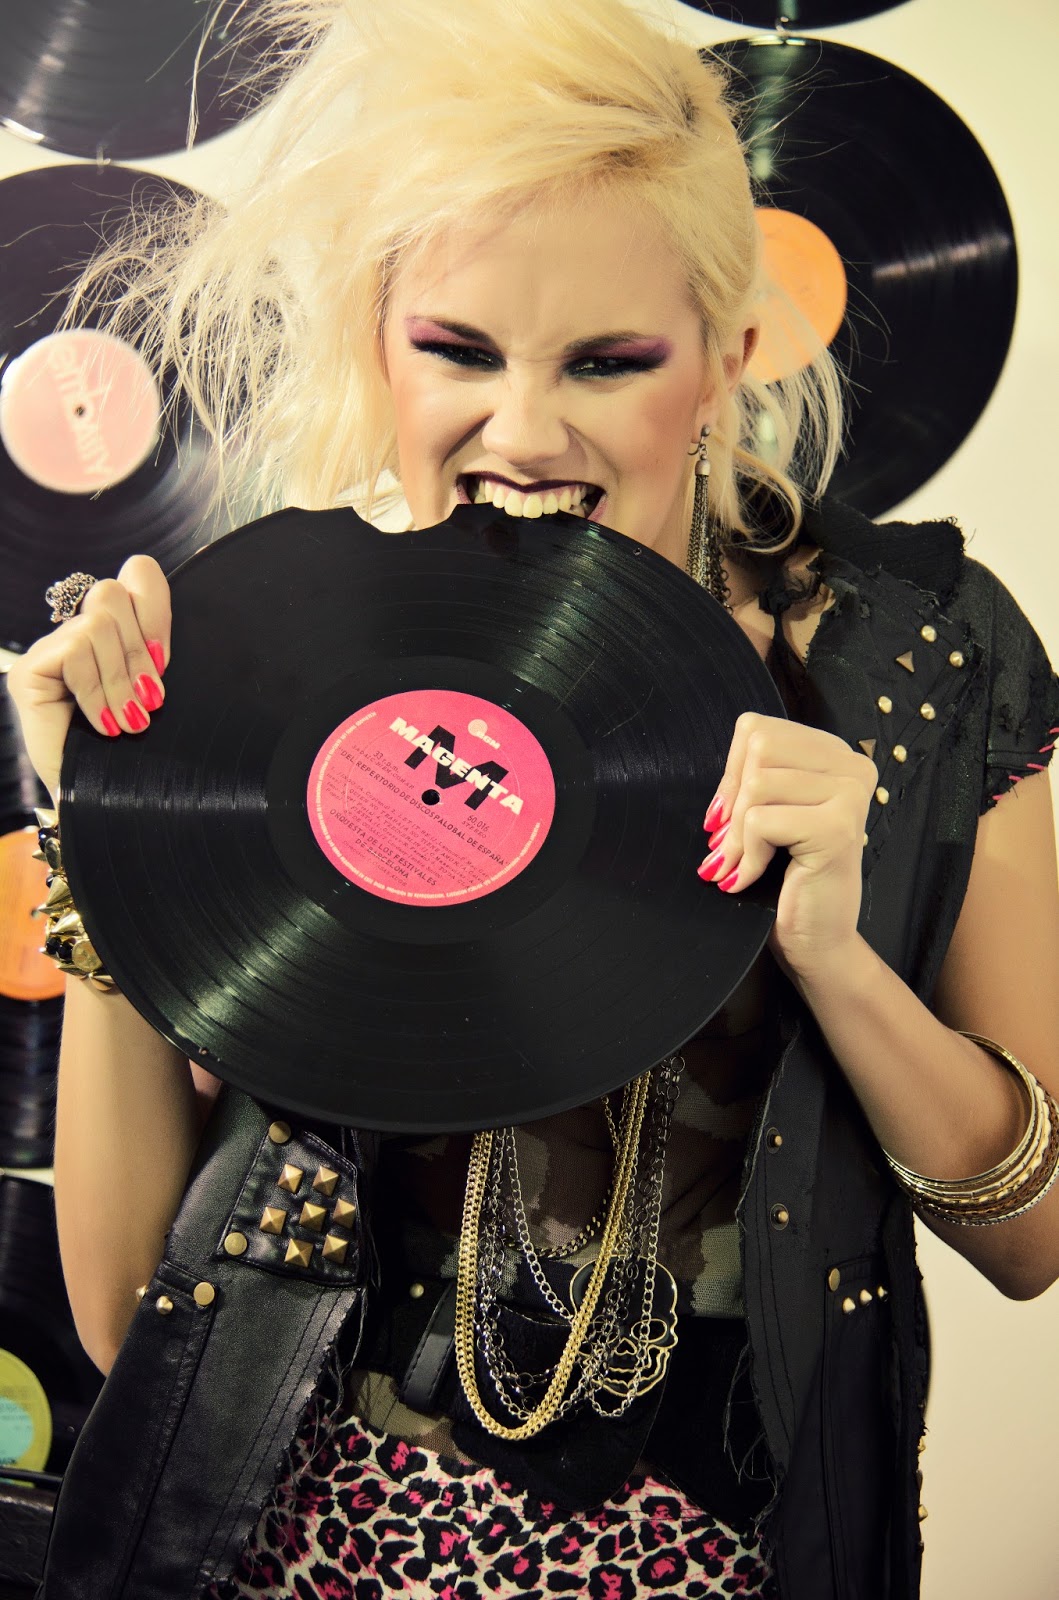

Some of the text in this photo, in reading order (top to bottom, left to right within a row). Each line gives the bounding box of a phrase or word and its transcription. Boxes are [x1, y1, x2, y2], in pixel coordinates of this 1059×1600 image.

[372, 750, 384, 761] 33
[389, 717, 524, 815] MAGENTA
[355, 760, 400, 794] REPERTORIO
[399, 791, 411, 801] DE
[466, 836, 479, 848] DE
[329, 809, 366, 838] ORQUESTA
[366, 835, 378, 846] DE
[378, 843, 394, 856] LOS
[393, 854, 437, 887] FESTIVALES
[366, 846, 409, 879] BARCELONA
